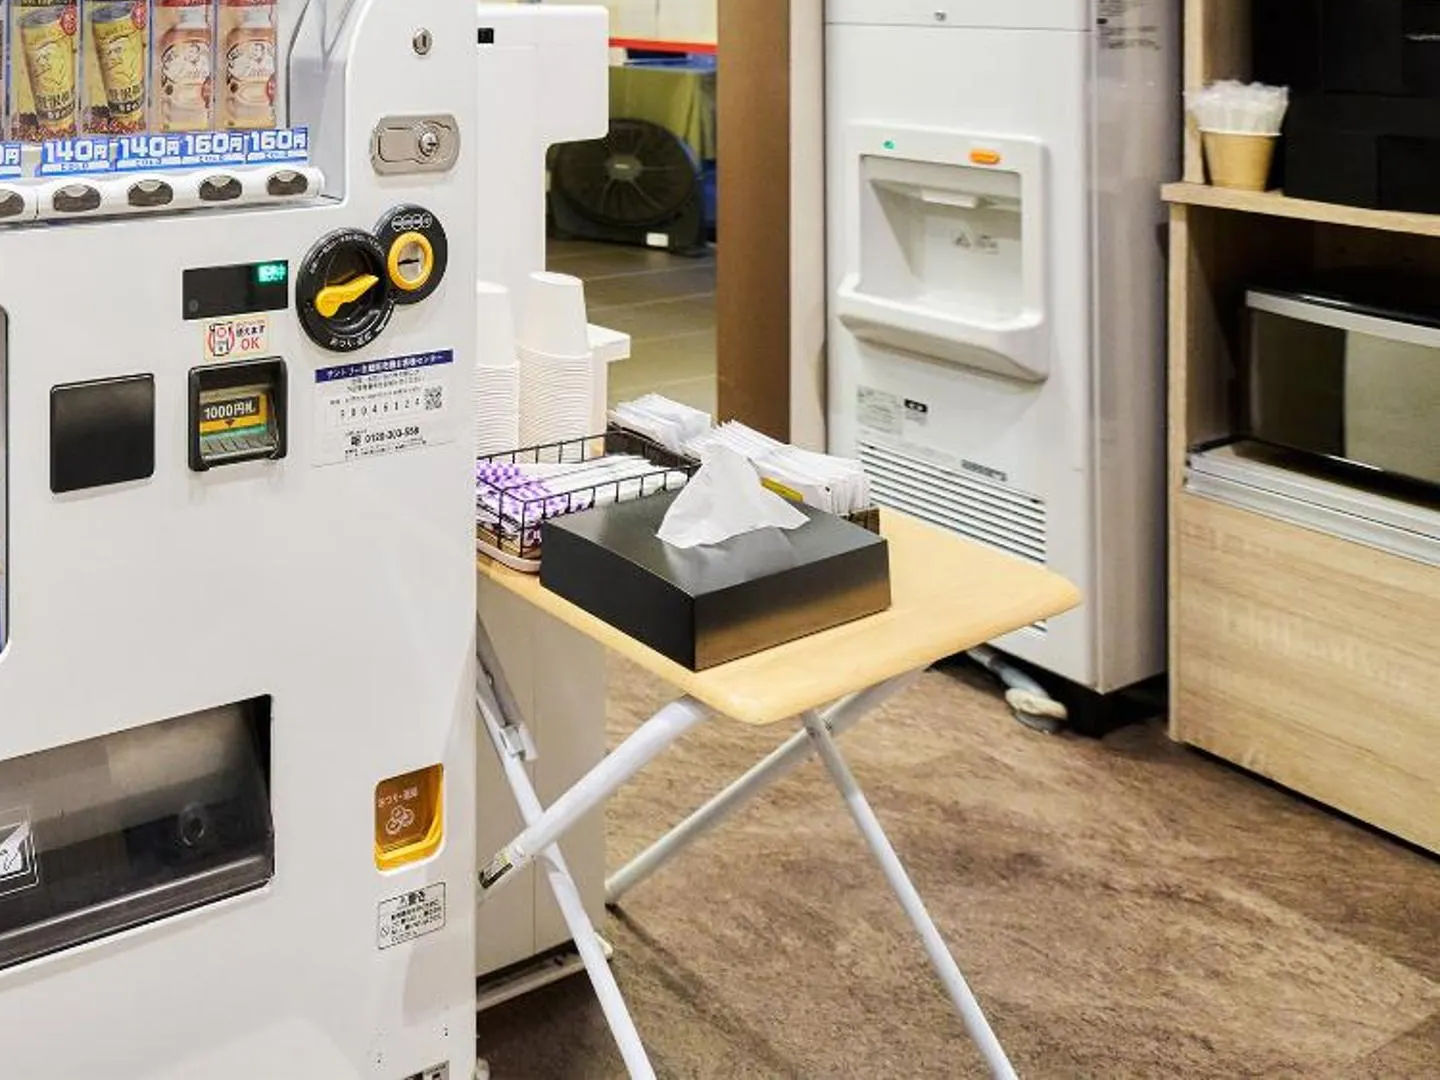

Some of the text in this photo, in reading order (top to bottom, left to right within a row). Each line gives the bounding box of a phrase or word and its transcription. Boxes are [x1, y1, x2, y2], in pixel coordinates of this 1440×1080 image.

[46, 141, 107, 162] 140円
[120, 137, 180, 159] 140円
[185, 133, 242, 155] 160円
[250, 130, 306, 152] 160円
[241, 337, 261, 351] OK
[204, 399, 256, 420] 1000円札
